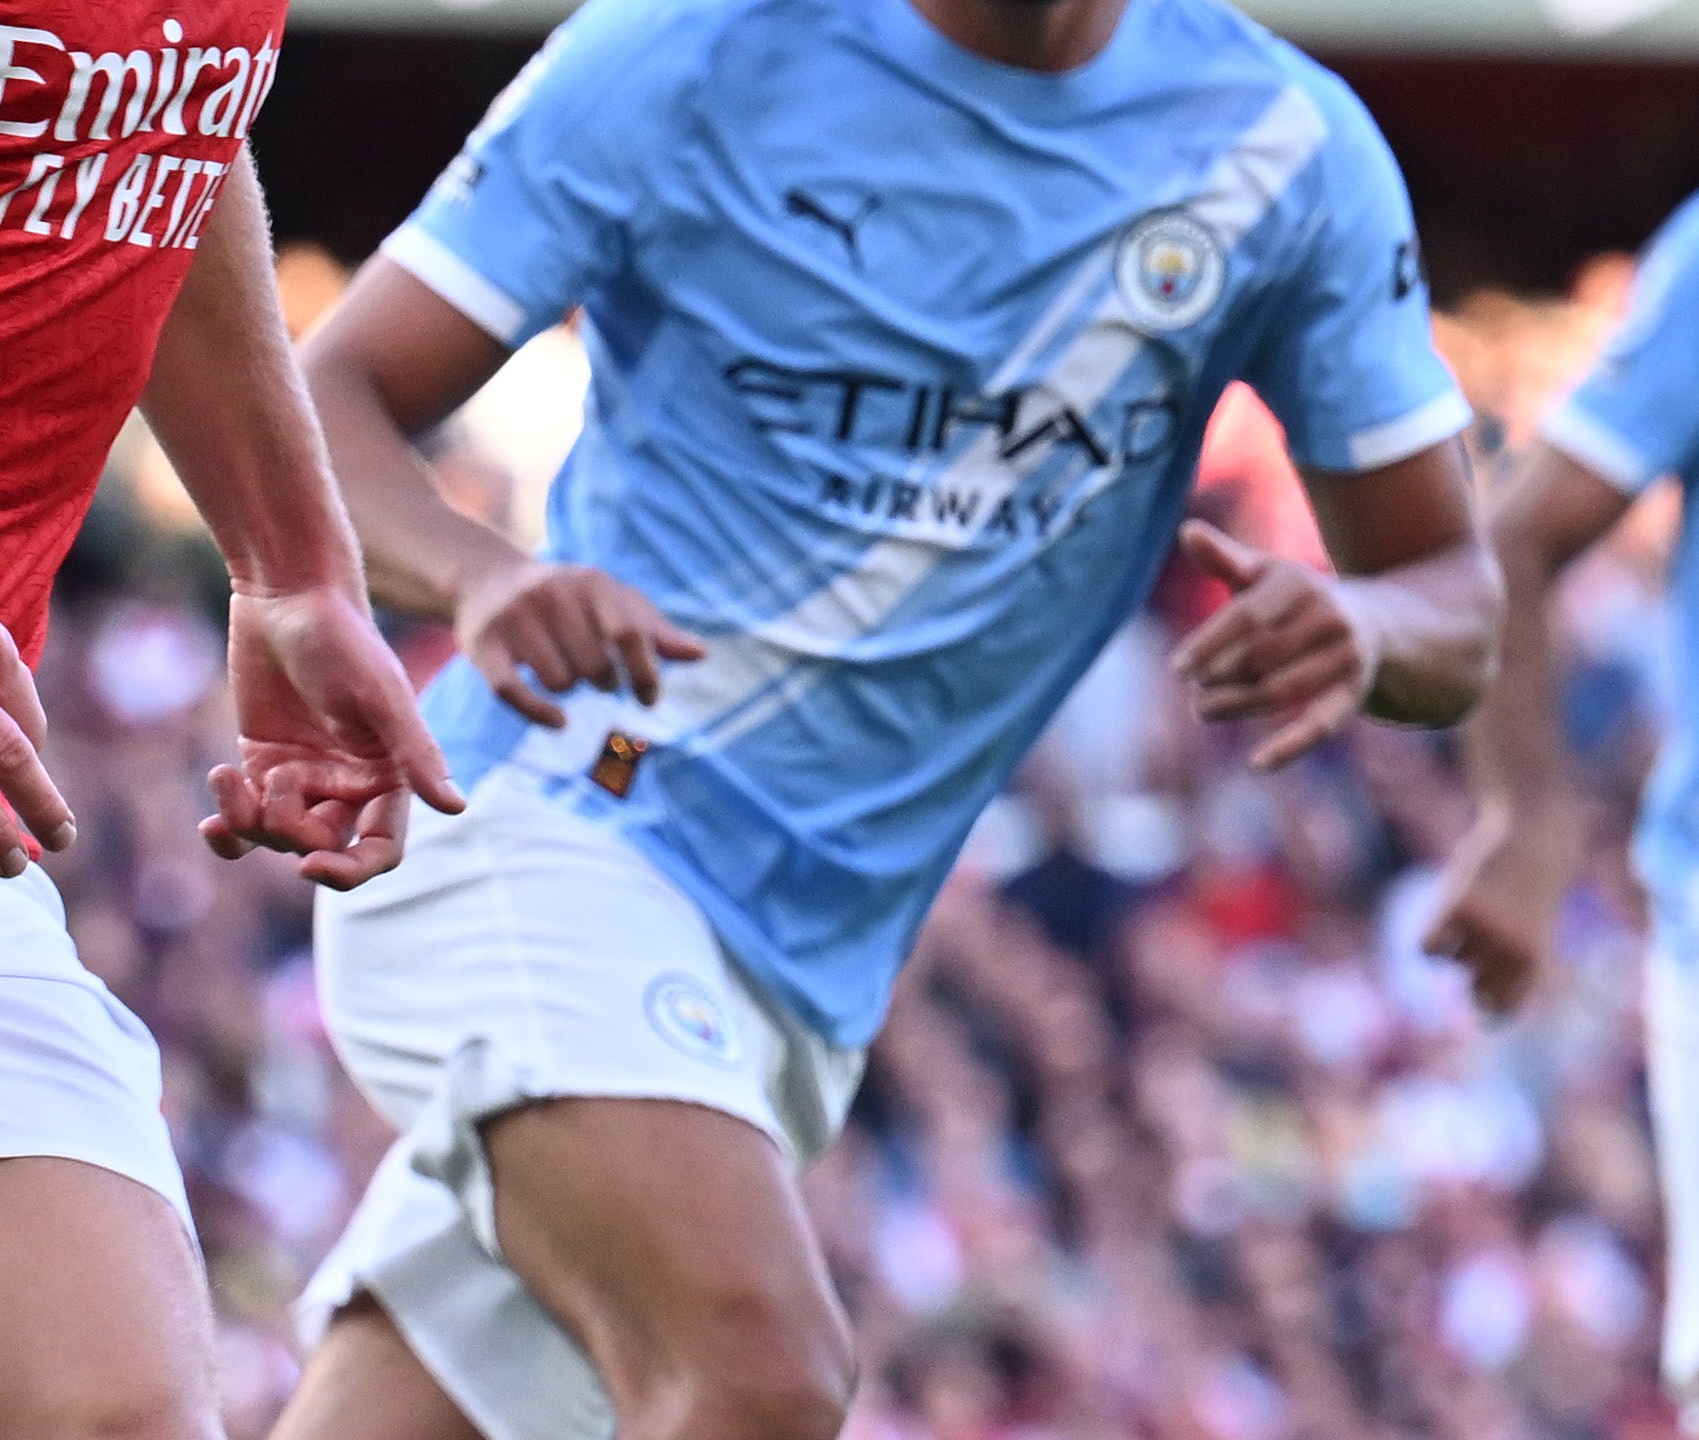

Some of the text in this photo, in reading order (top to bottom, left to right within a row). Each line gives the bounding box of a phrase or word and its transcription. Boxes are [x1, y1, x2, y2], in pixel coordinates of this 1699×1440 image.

[104, 154, 230, 250] BETTE
[725, 355, 1180, 466] ETIHAD
[816, 468, 1095, 538] AIRWAY
